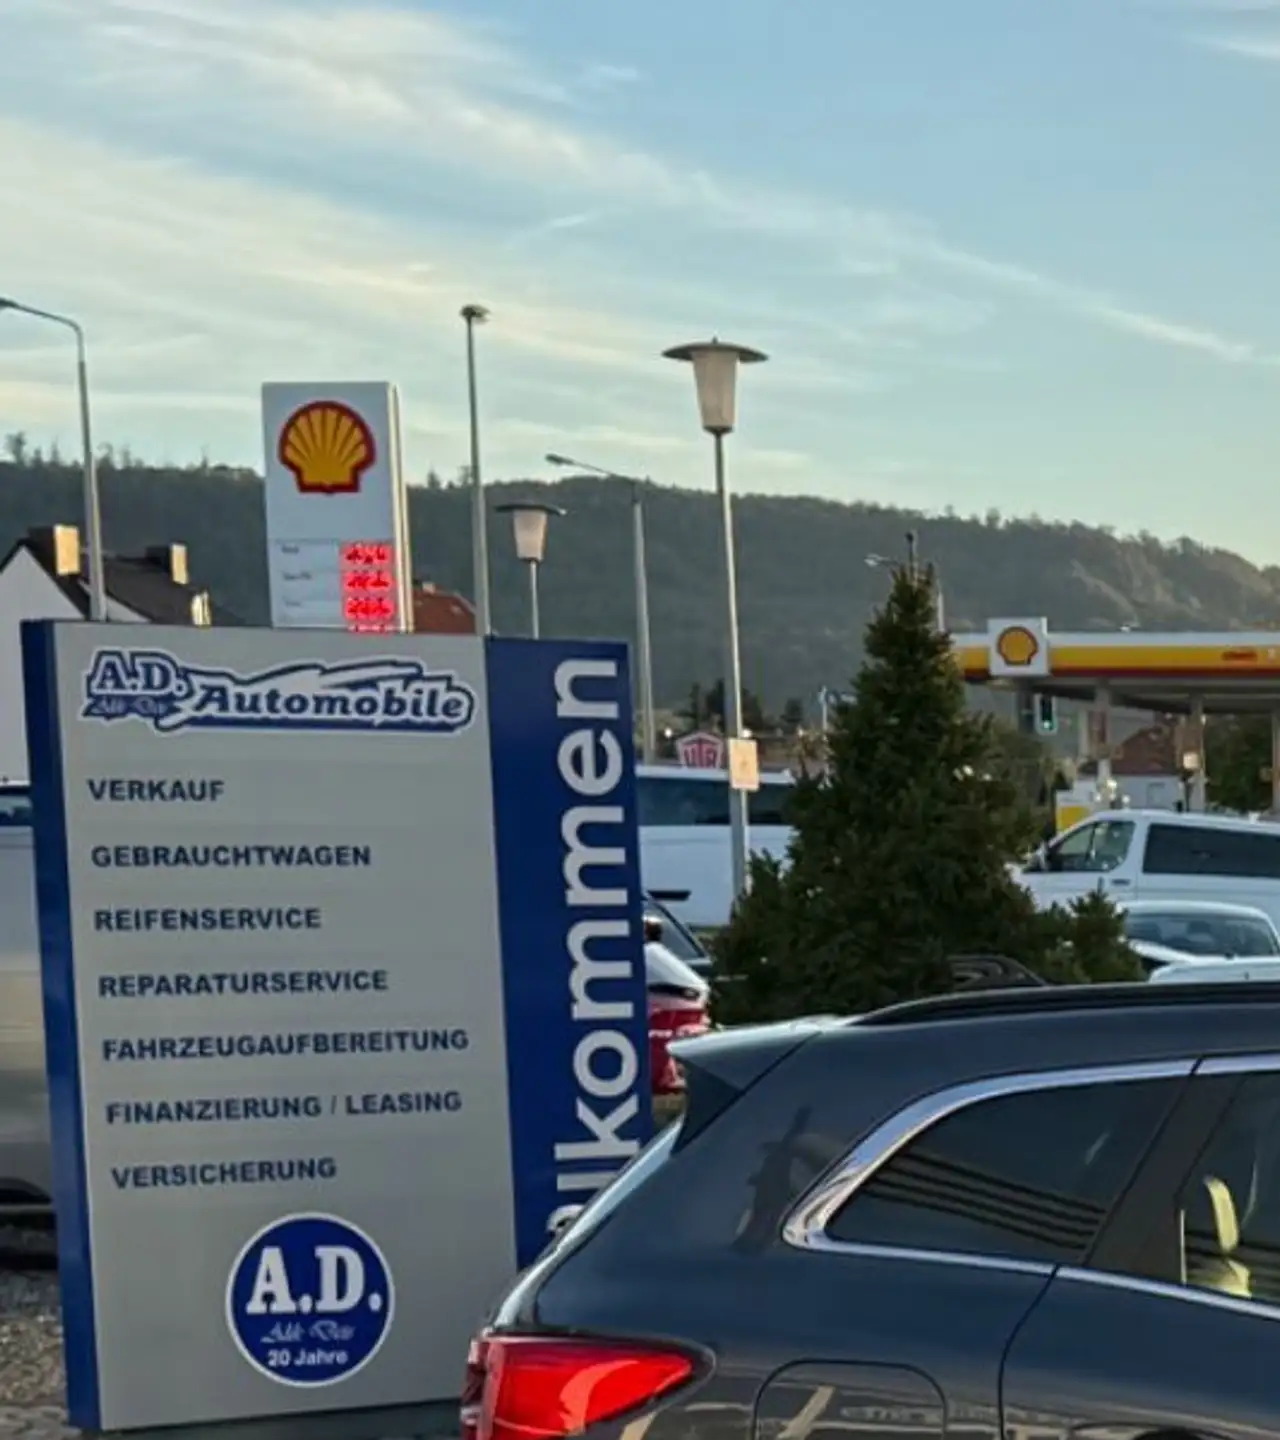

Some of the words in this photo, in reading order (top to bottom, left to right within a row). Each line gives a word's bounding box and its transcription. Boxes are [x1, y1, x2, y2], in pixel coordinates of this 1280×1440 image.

[196, 680, 469, 721] Automobile
[88, 780, 225, 801] VERKAUF
[91, 845, 371, 868] GEBRAUCHTWAGEN
[94, 907, 322, 932] REIFENSERVICE
[546, 658, 640, 1233] lkommen
[98, 969, 389, 998] REPARATURSERVICE
[103, 1029, 469, 1060] FAHRZEUGAUFBEREITUNG
[106, 1096, 322, 1125] FINANZIERUNG
[345, 1090, 463, 1115] LEASING
[111, 1156, 338, 1189] VERSICHERUNG
[245, 1245, 382, 1315] A.D.
[267, 1350, 291, 1368] 20
[294, 1349, 348, 1367] Jahre
